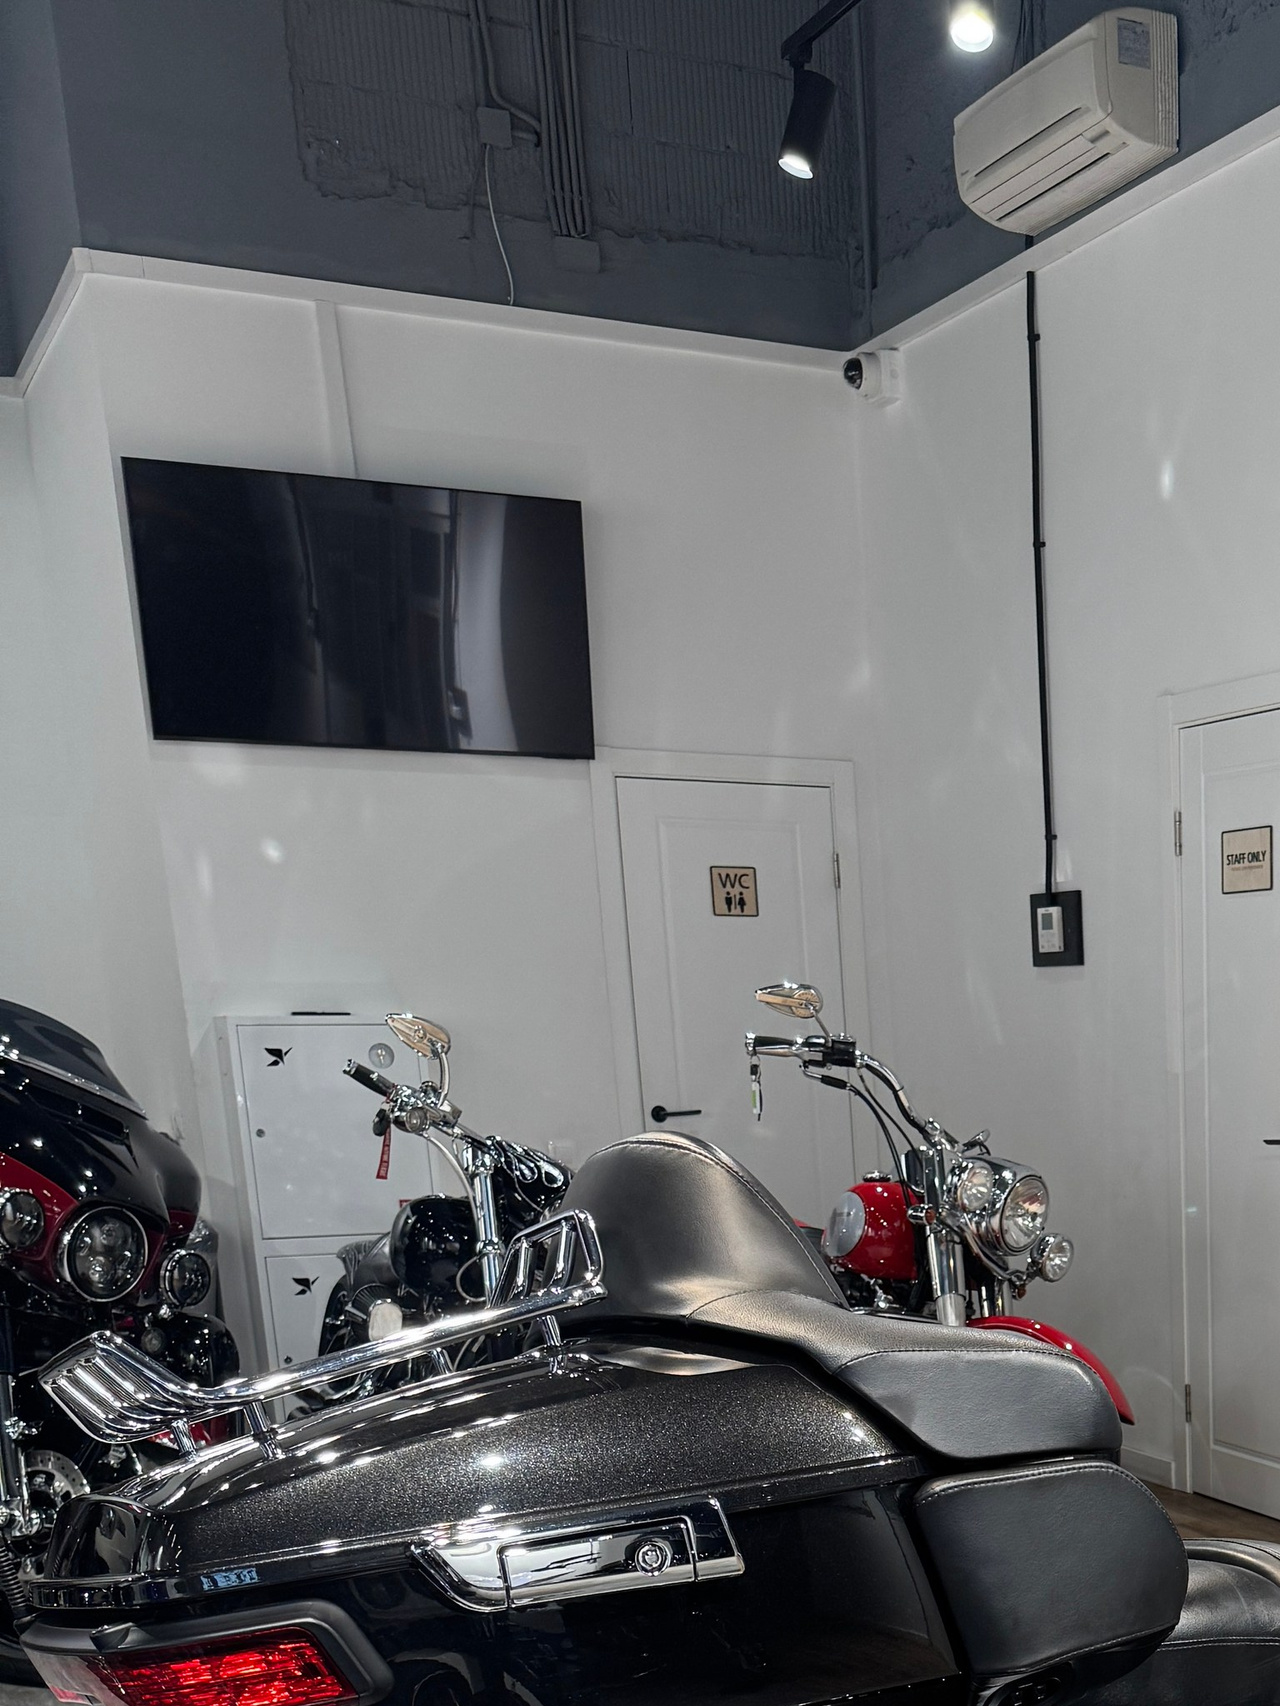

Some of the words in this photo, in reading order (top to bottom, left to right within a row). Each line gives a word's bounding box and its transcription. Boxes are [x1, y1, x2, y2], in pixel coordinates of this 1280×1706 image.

[1226, 852, 1247, 866] STAFF
[1247, 850, 1267, 864] ONLY
[718, 872, 750, 889] WC
